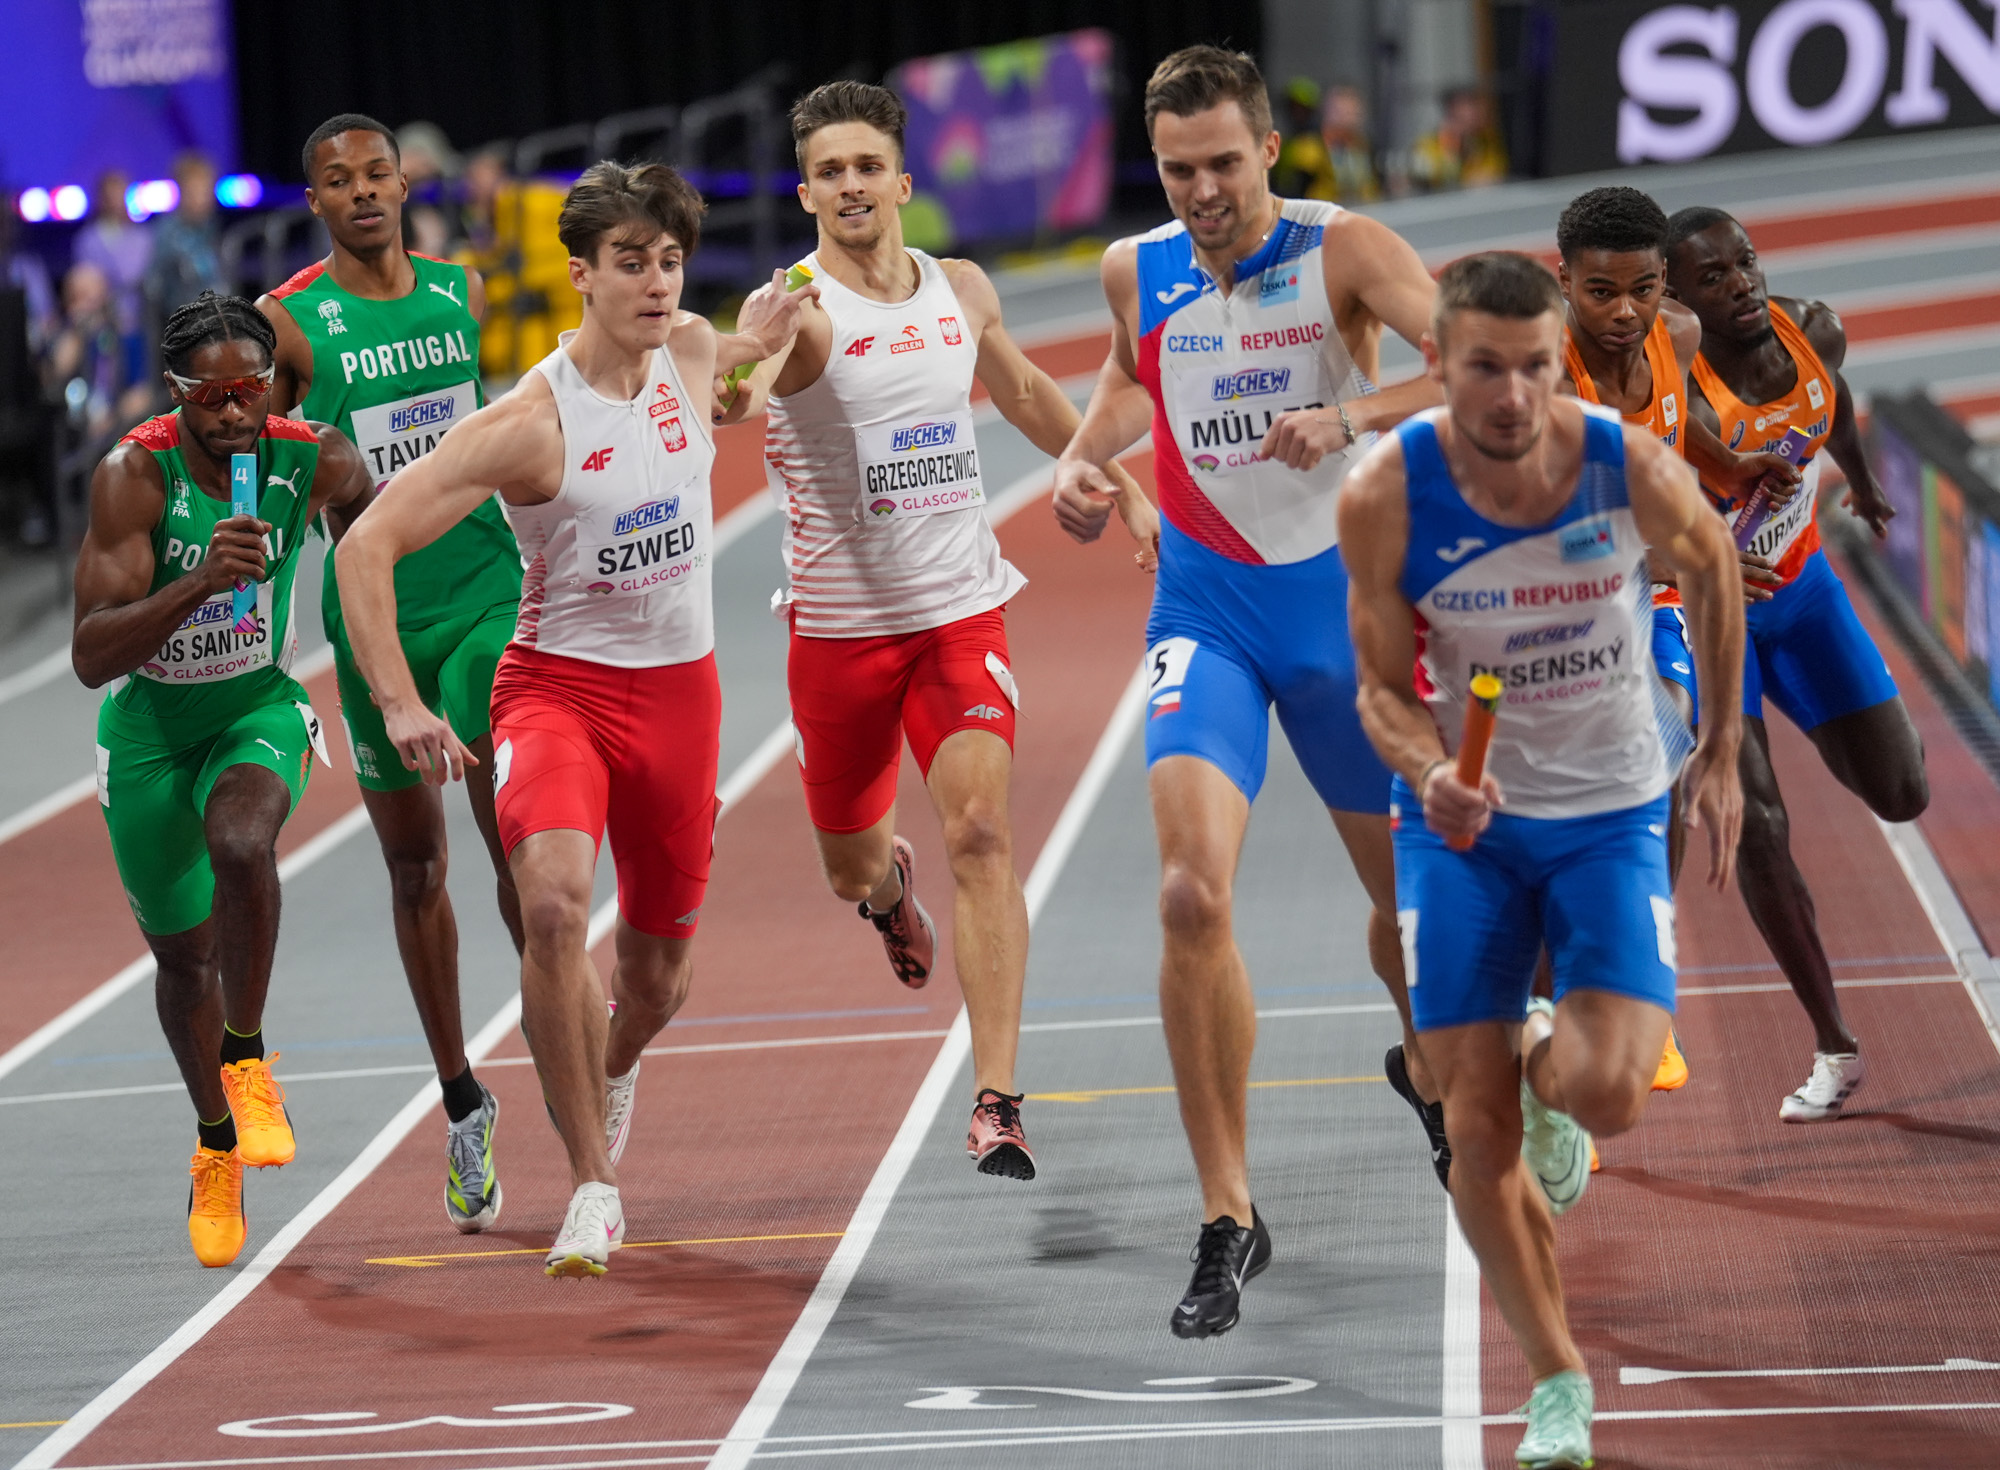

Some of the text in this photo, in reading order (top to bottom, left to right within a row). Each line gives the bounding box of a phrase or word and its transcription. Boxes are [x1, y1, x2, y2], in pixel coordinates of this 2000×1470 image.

[1616, 0, 2000, 166] SON
[328, 324, 347, 336] FPA
[1168, 322, 1324, 352] CZECH REPUBLIC
[340, 330, 471, 384] PORTUGAL
[844, 336, 875, 357] 4F
[891, 339, 924, 354] ORLEN
[1211, 368, 1290, 400] HI-CHEW
[389, 396, 454, 432] HI-CHEW
[649, 399, 679, 417] ORLEN
[890, 421, 956, 451] HI-CHEW
[1191, 402, 1324, 449] MÜLL
[581, 447, 614, 472] 4F
[866, 450, 978, 494] GRZEGORZEWICZ
[235, 468, 248, 485] 4
[172, 506, 190, 518] FPA
[902, 487, 981, 510] GLASGOW 24
[612, 495, 679, 536] HI-CHEW
[597, 522, 694, 576] SZWED
[621, 560, 692, 591] GLASGOW
[1432, 573, 1624, 611] CZECH REPUBLIC
[158, 638, 185, 663] OS
[174, 651, 267, 679] GLASGOW 24
[1151, 648, 1169, 689] 5
[1506, 678, 1602, 704] GLASGOW
[964, 704, 1004, 720] 4F
